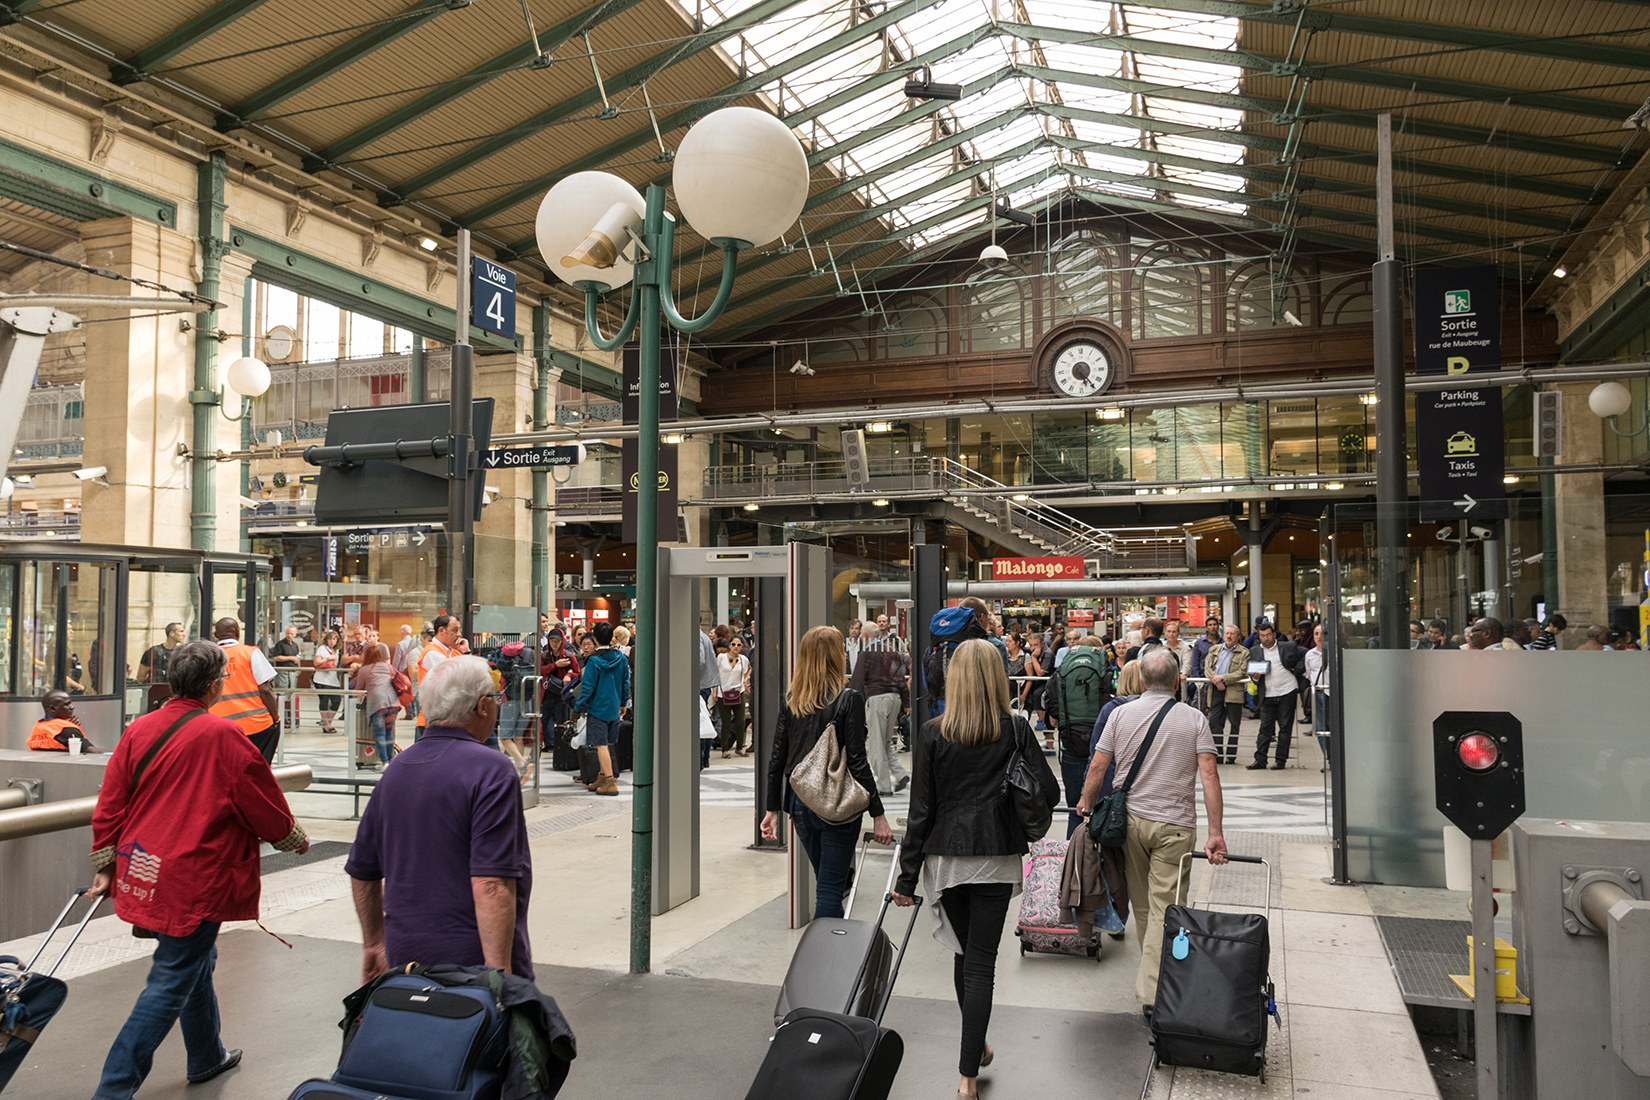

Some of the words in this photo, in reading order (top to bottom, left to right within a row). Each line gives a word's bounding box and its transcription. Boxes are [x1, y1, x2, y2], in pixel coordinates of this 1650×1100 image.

[486, 263, 507, 285] Voie
[486, 291, 505, 330] 4
[1441, 319, 1477, 331] Sortie
[1441, 390, 1479, 400] Parking
[503, 450, 540, 464] Sortie
[542, 456, 571, 464] Ausgang
[1448, 460, 1476, 470] Taxis
[348, 532, 374, 543] Sortie
[996, 560, 1063, 578] Malongo
